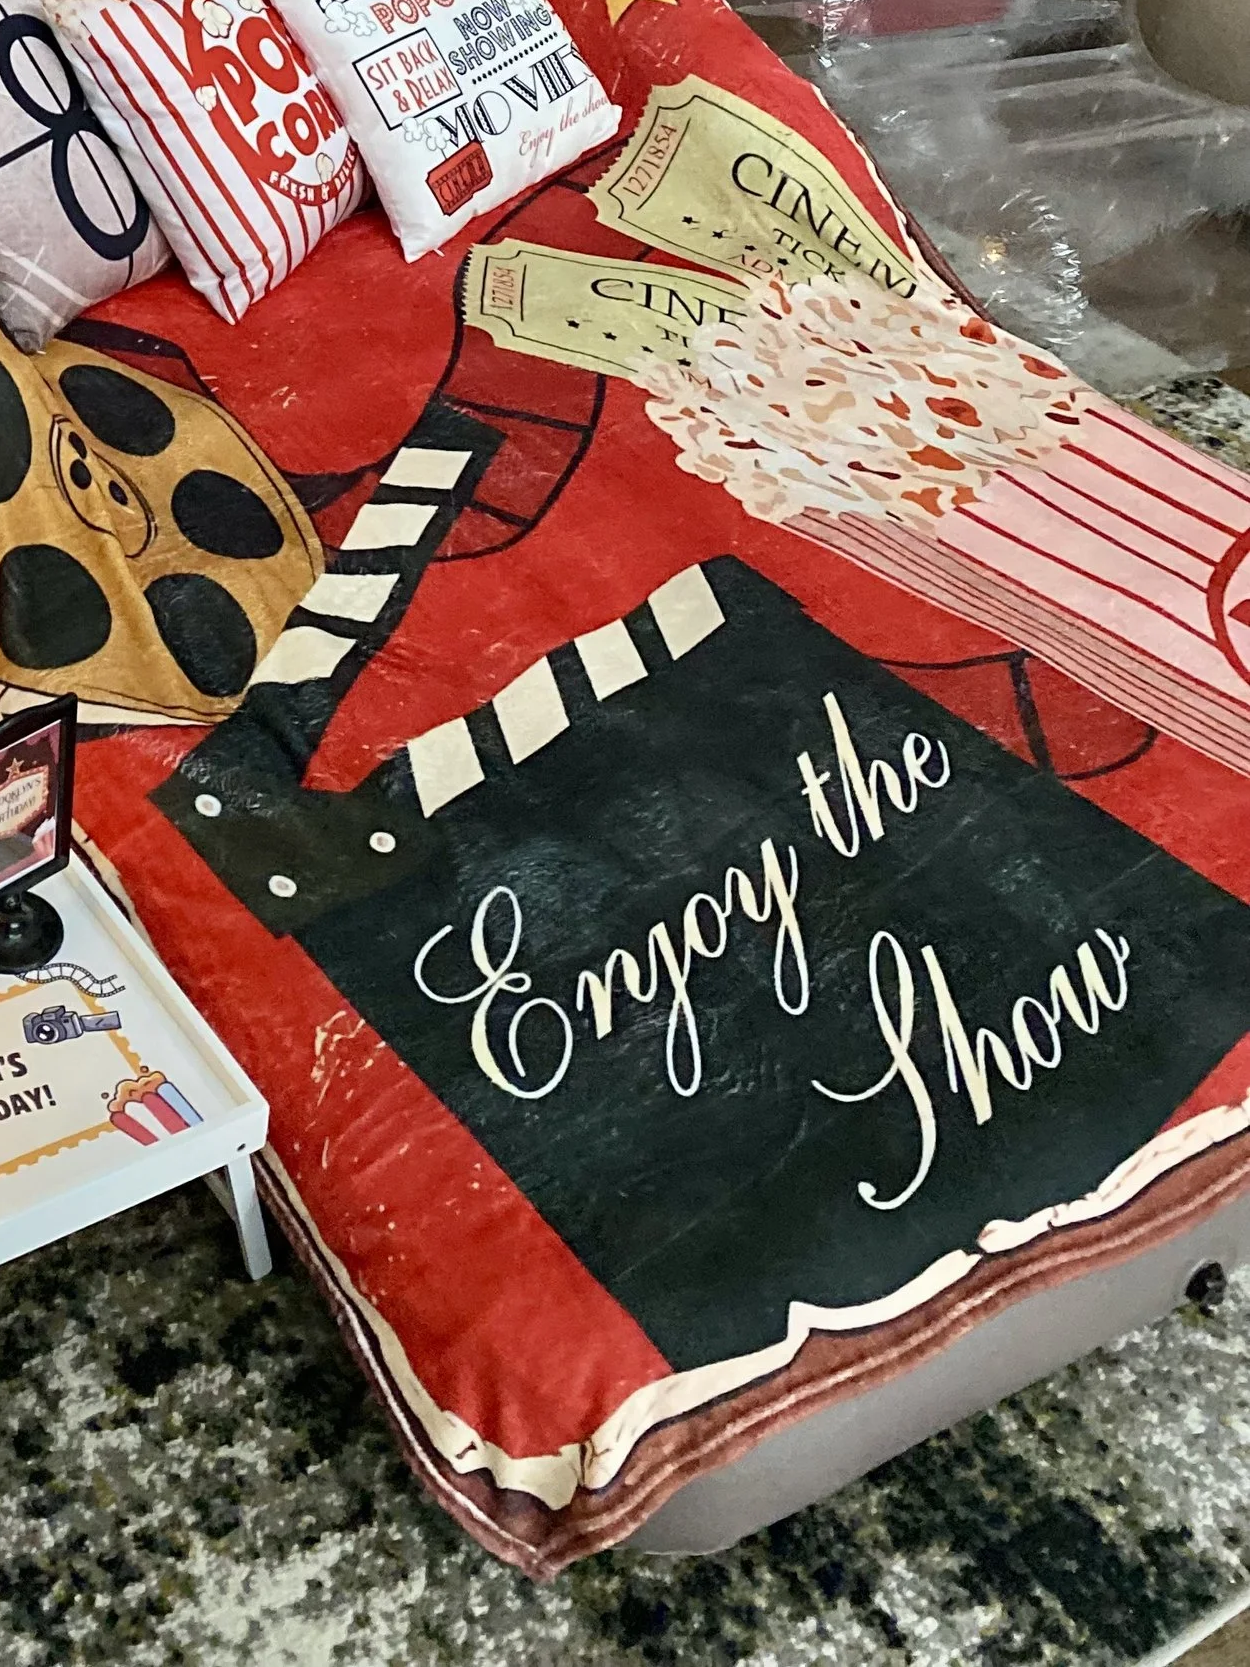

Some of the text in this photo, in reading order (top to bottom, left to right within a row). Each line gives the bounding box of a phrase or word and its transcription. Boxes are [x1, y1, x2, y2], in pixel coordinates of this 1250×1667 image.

[366, 38, 439, 91] SIT BACK
[448, 3, 552, 76] SHOWING
[392, 65, 457, 114] & RELAX
[518, 124, 556, 169] Enjoy
[559, 96, 580, 132] the
[621, 122, 678, 198] 1271854
[269, 171, 315, 202] FRESH
[489, 265, 517, 311] 1271854
[414, 691, 952, 1100] Enjoy the
[811, 928, 1131, 1212] Show
